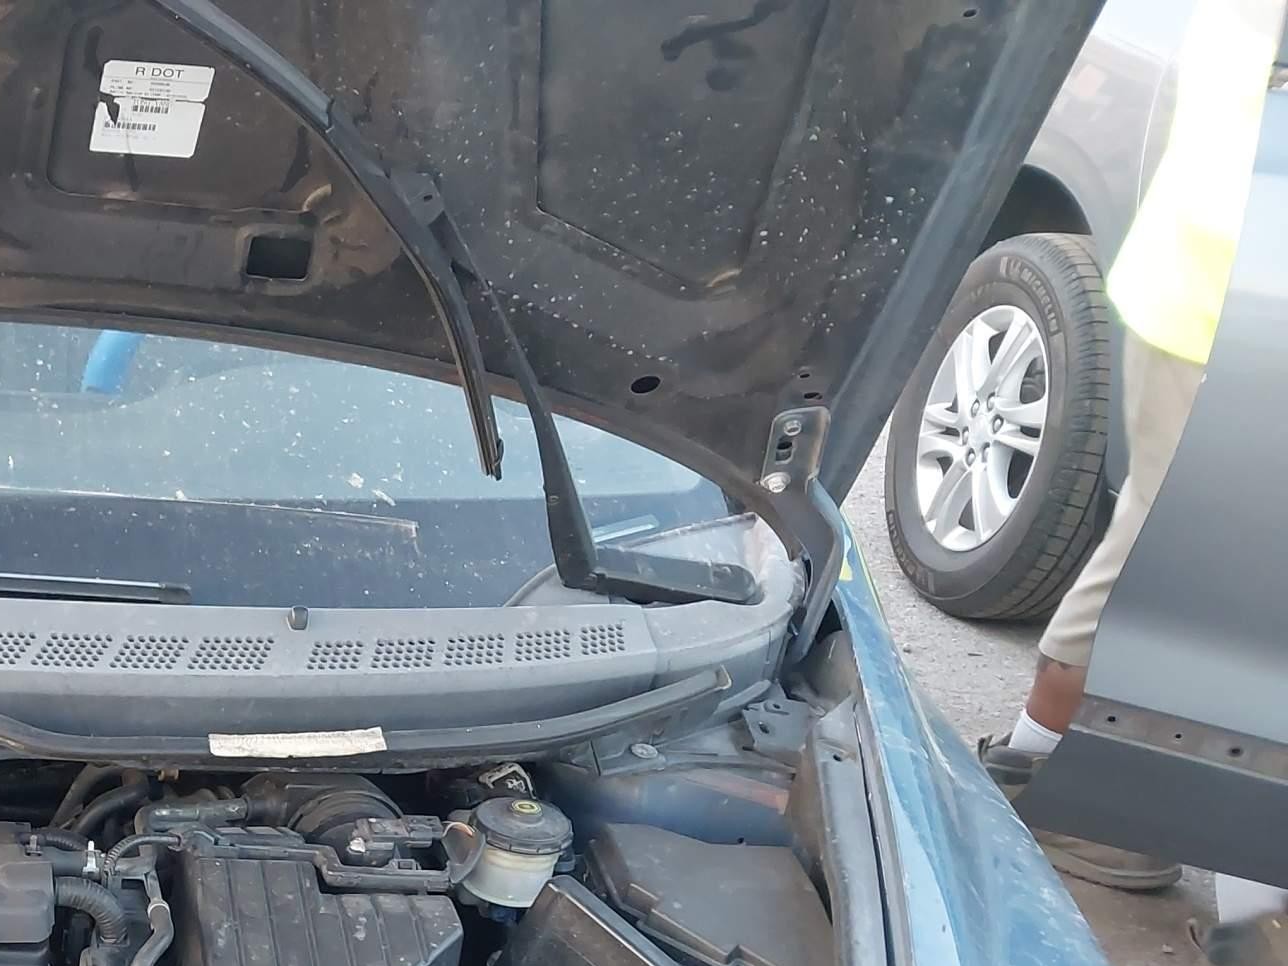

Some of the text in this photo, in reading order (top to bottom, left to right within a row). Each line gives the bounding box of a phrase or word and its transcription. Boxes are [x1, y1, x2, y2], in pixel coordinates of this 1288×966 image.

[135, 66, 185, 79] R DOT
[1020, 267, 1059, 333] MICHELIN
